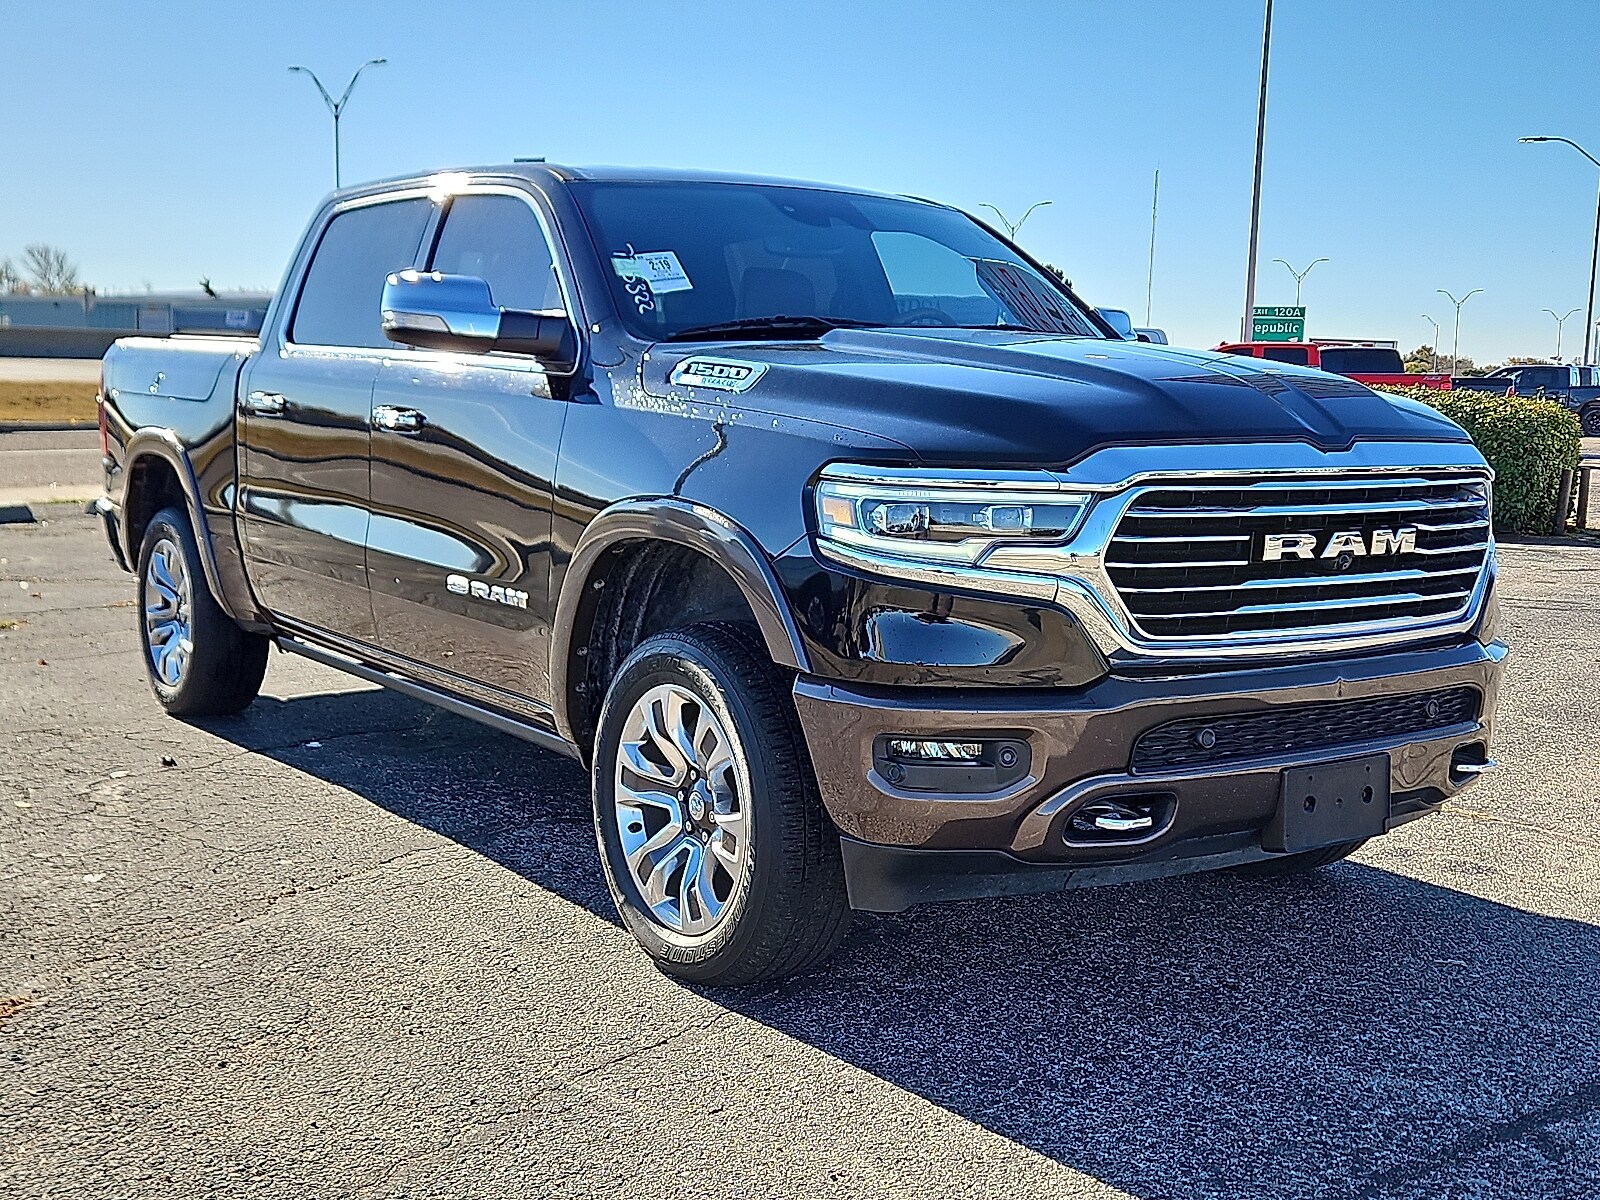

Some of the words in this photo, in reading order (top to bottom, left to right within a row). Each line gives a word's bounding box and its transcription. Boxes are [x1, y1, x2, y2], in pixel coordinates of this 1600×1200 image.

[649, 260, 672, 272] 2:19
[1274, 307, 1301, 317] 120A
[1252, 322, 1300, 335] epublic
[688, 362, 750, 380] 1500
[1262, 527, 1417, 562] RAM
[470, 580, 529, 610] RAM
